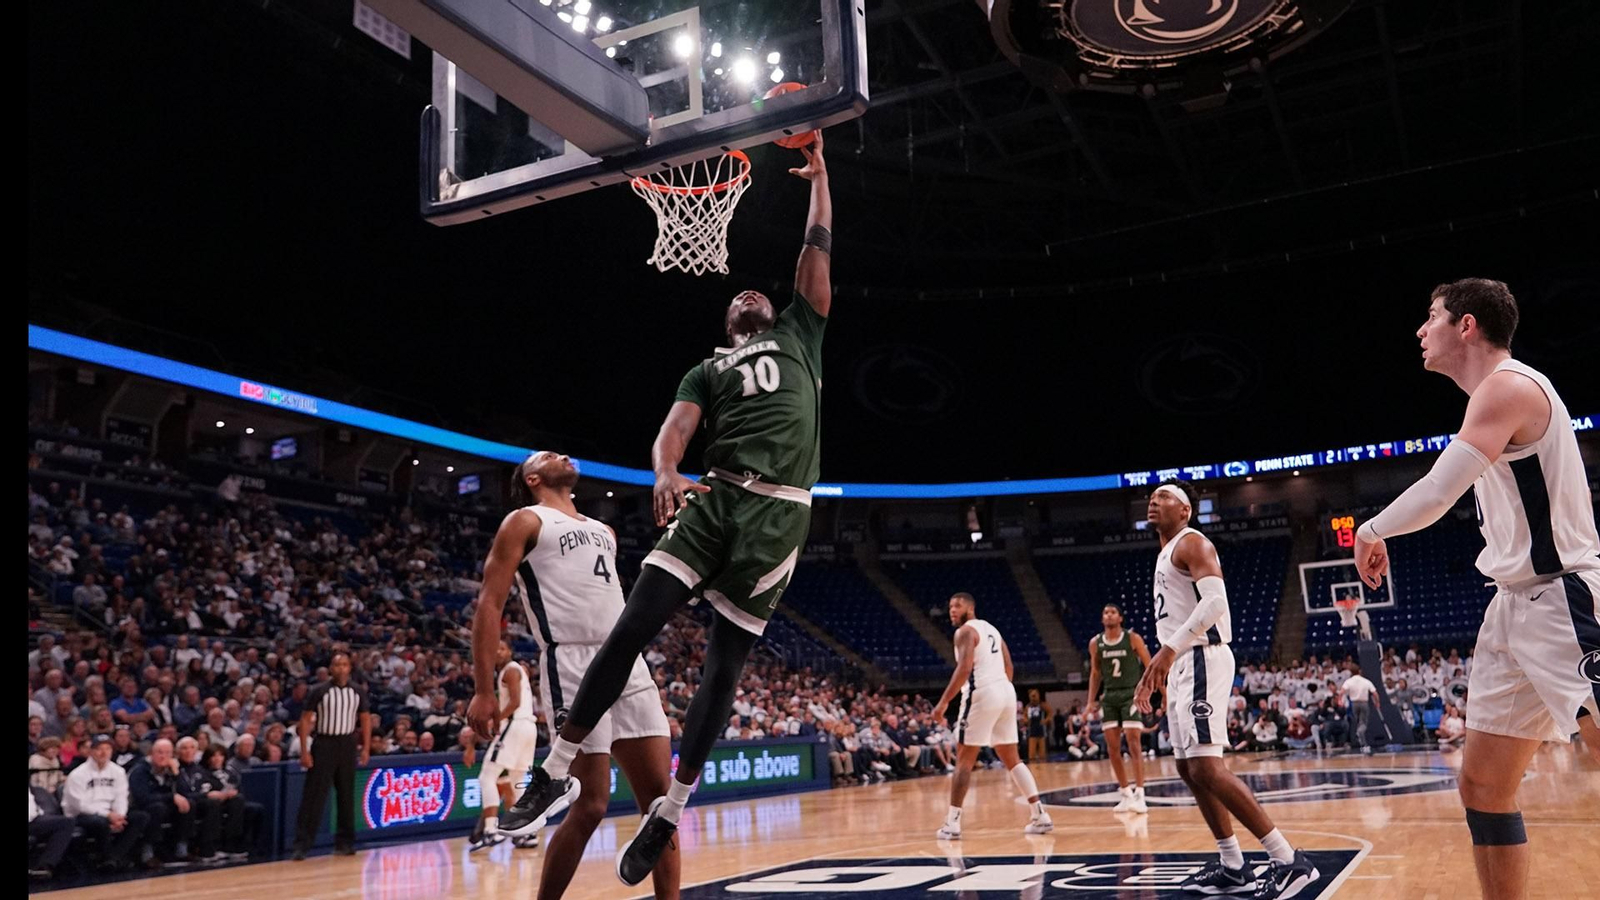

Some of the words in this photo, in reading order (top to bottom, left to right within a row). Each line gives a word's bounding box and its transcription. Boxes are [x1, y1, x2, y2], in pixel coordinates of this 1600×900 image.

[714, 340, 781, 375] LOYOLA
[734, 355, 780, 397] 10
[1255, 457, 1282, 473] PENN
[1282, 453, 1314, 470] STATE
[1326, 450, 1342, 465] 21
[1331, 515, 1355, 532] 8:50
[559, 530, 591, 556] PENN
[1336, 526, 1355, 548] 13
[594, 554, 611, 584] 4
[988, 634, 998, 654] 2
[1111, 658, 1122, 678] 2
[704, 761, 717, 785] a
[720, 751, 751, 783] sub
[754, 750, 800, 780] above
[377, 769, 444, 798] Jersey
